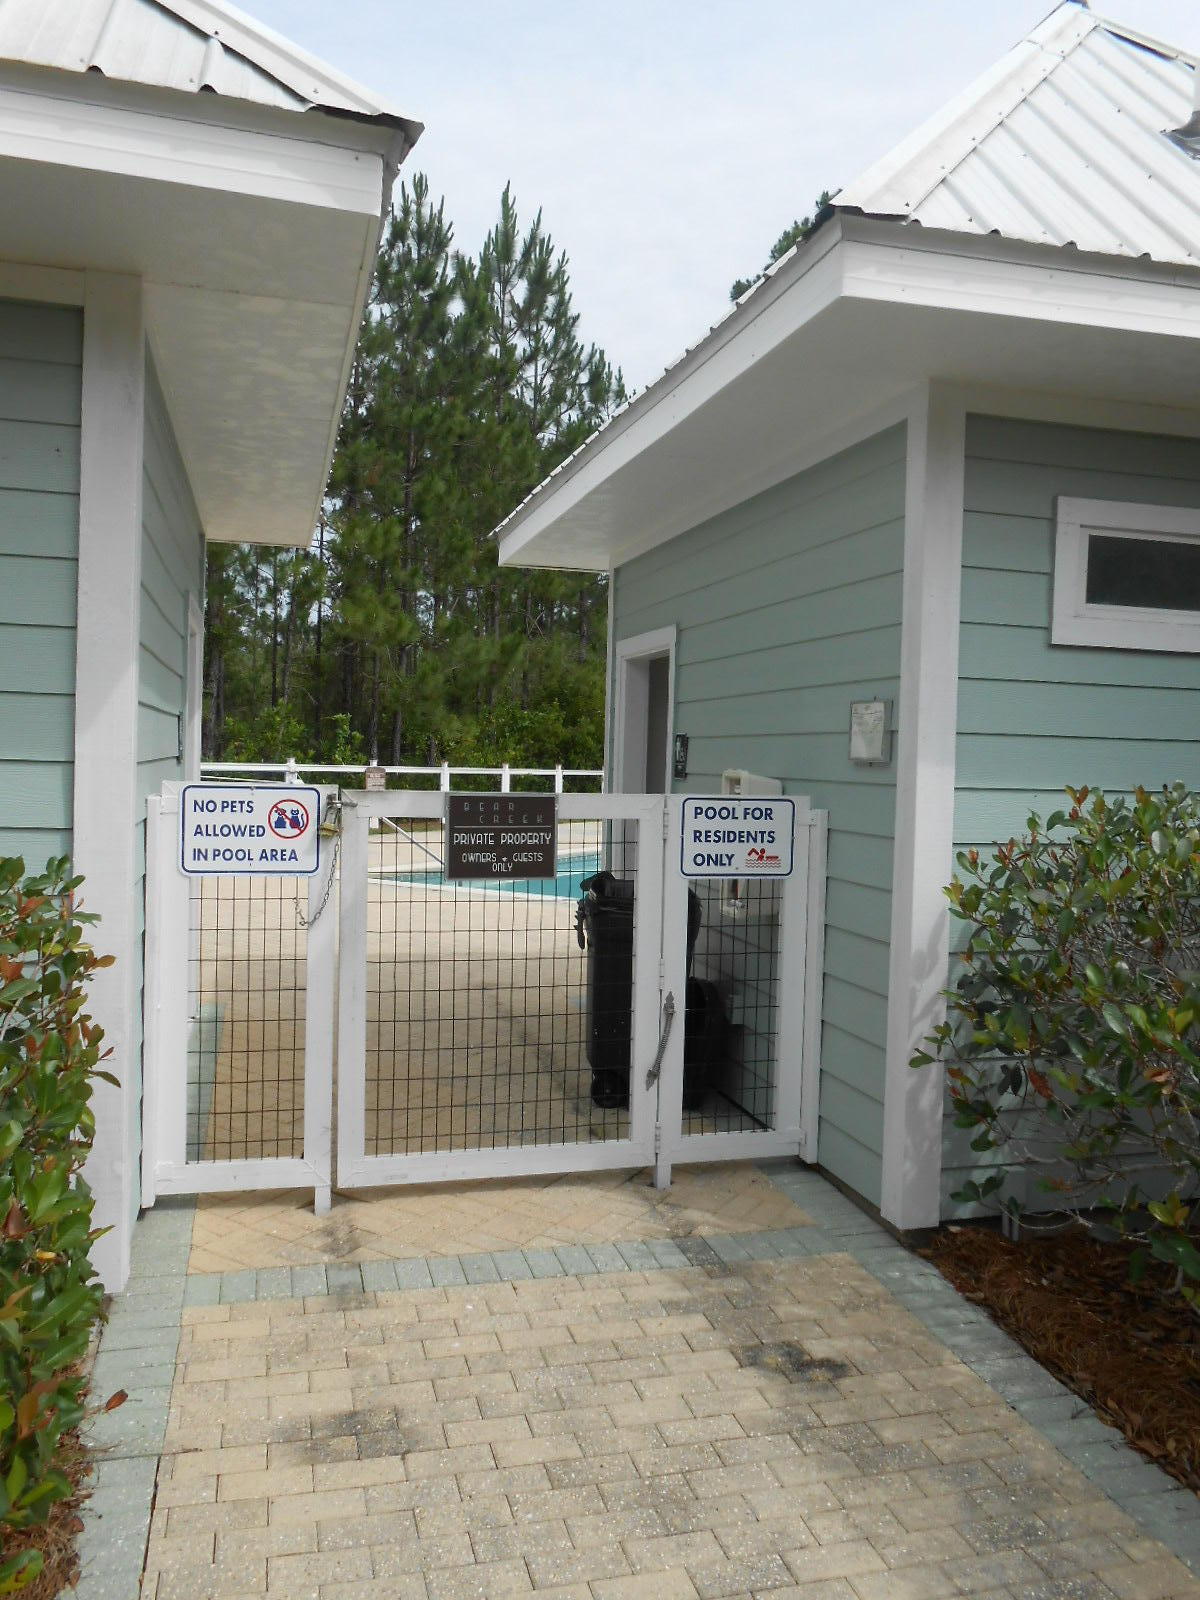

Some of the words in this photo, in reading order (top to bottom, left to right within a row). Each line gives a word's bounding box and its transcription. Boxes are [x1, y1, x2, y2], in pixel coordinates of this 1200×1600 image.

[193, 799, 217, 813] NO
[221, 799, 254, 814] PETS
[463, 802, 515, 812] BEAR
[694, 806, 739, 820] POOL
[743, 807, 774, 821] FOR
[479, 814, 544, 824] CREEK
[193, 824, 266, 838] ALLOWED
[693, 829, 776, 844] RESIDENTS
[453, 833, 495, 845] PRIVATE
[500, 832, 552, 845] PROPERTY
[193, 848, 209, 862] IN
[212, 848, 254, 862] POOL
[260, 848, 299, 862] AREA
[462, 852, 497, 863] OWNERS
[512, 852, 544, 862] GUESTS
[692, 852, 735, 867] ONLY
[492, 862, 513, 872] ONLY
